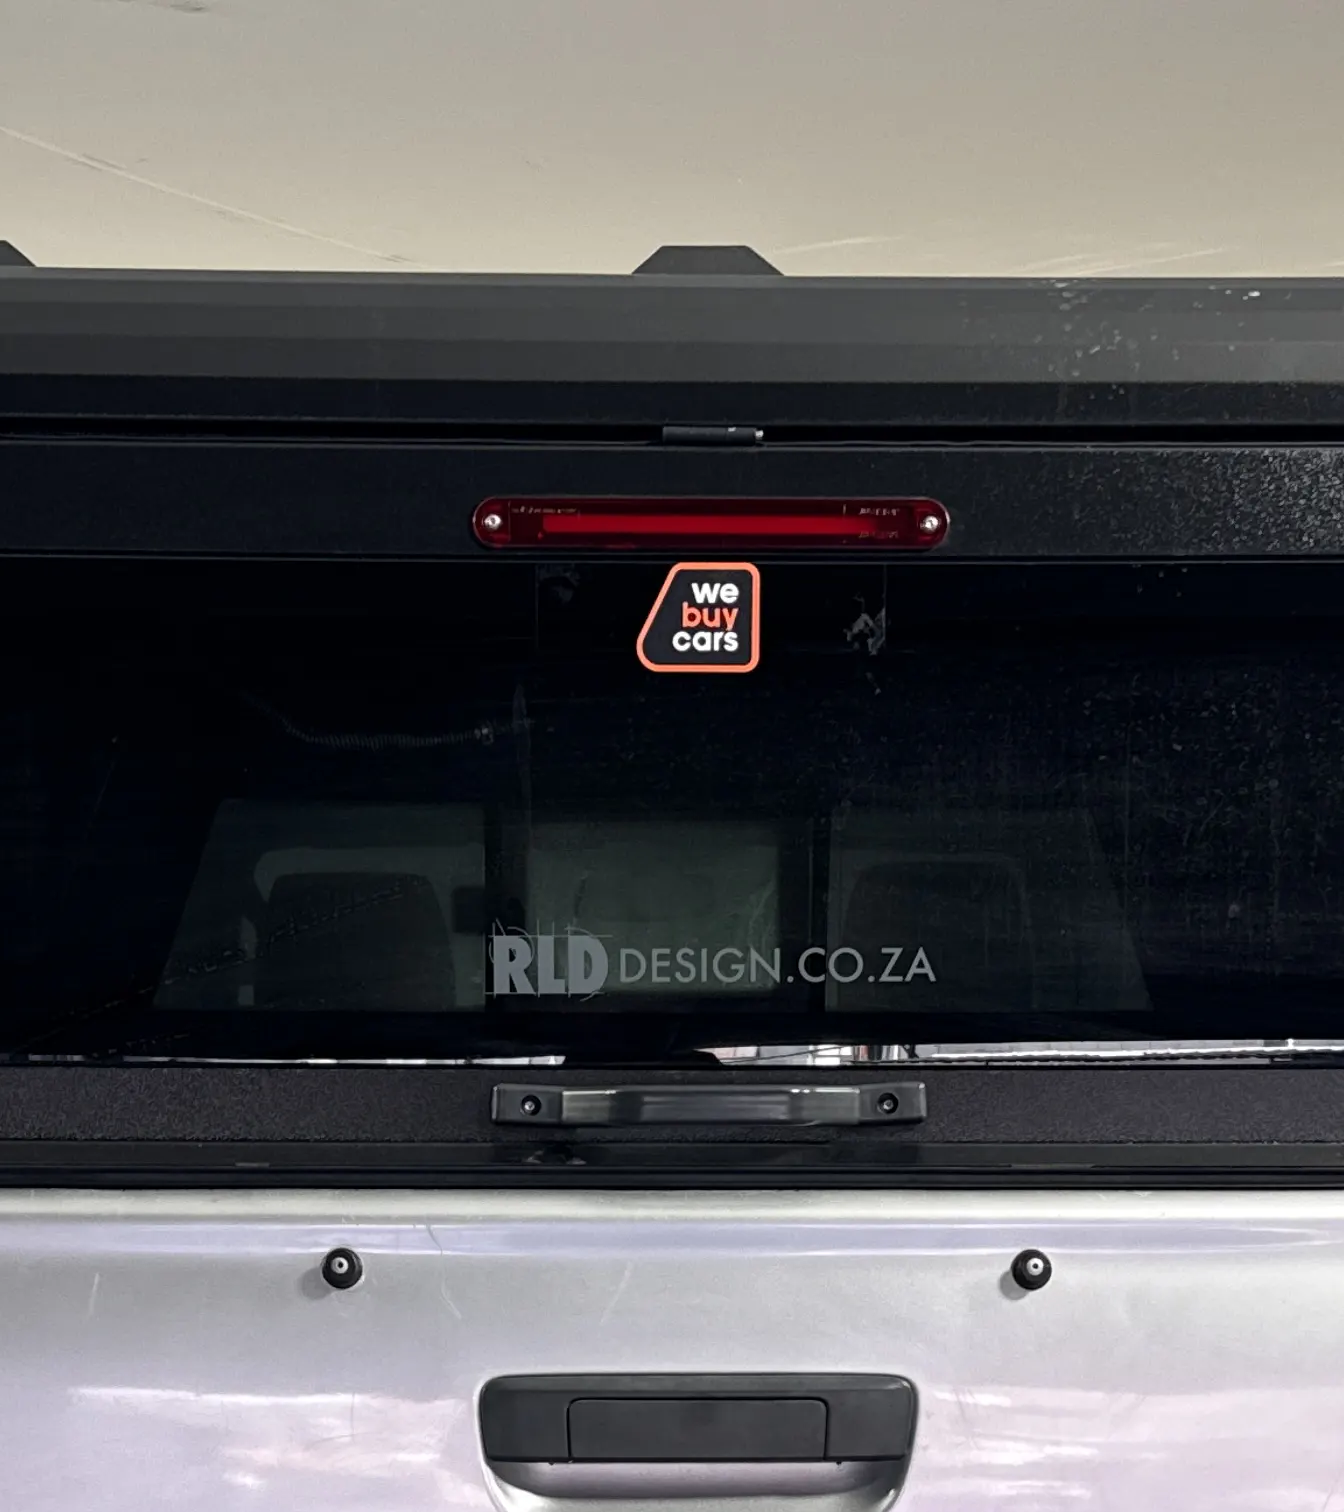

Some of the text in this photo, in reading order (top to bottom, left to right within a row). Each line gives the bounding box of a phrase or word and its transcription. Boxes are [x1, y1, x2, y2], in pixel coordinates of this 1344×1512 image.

[691, 582, 739, 604] we
[682, 601, 739, 631] buy
[672, 631, 739, 652] cars
